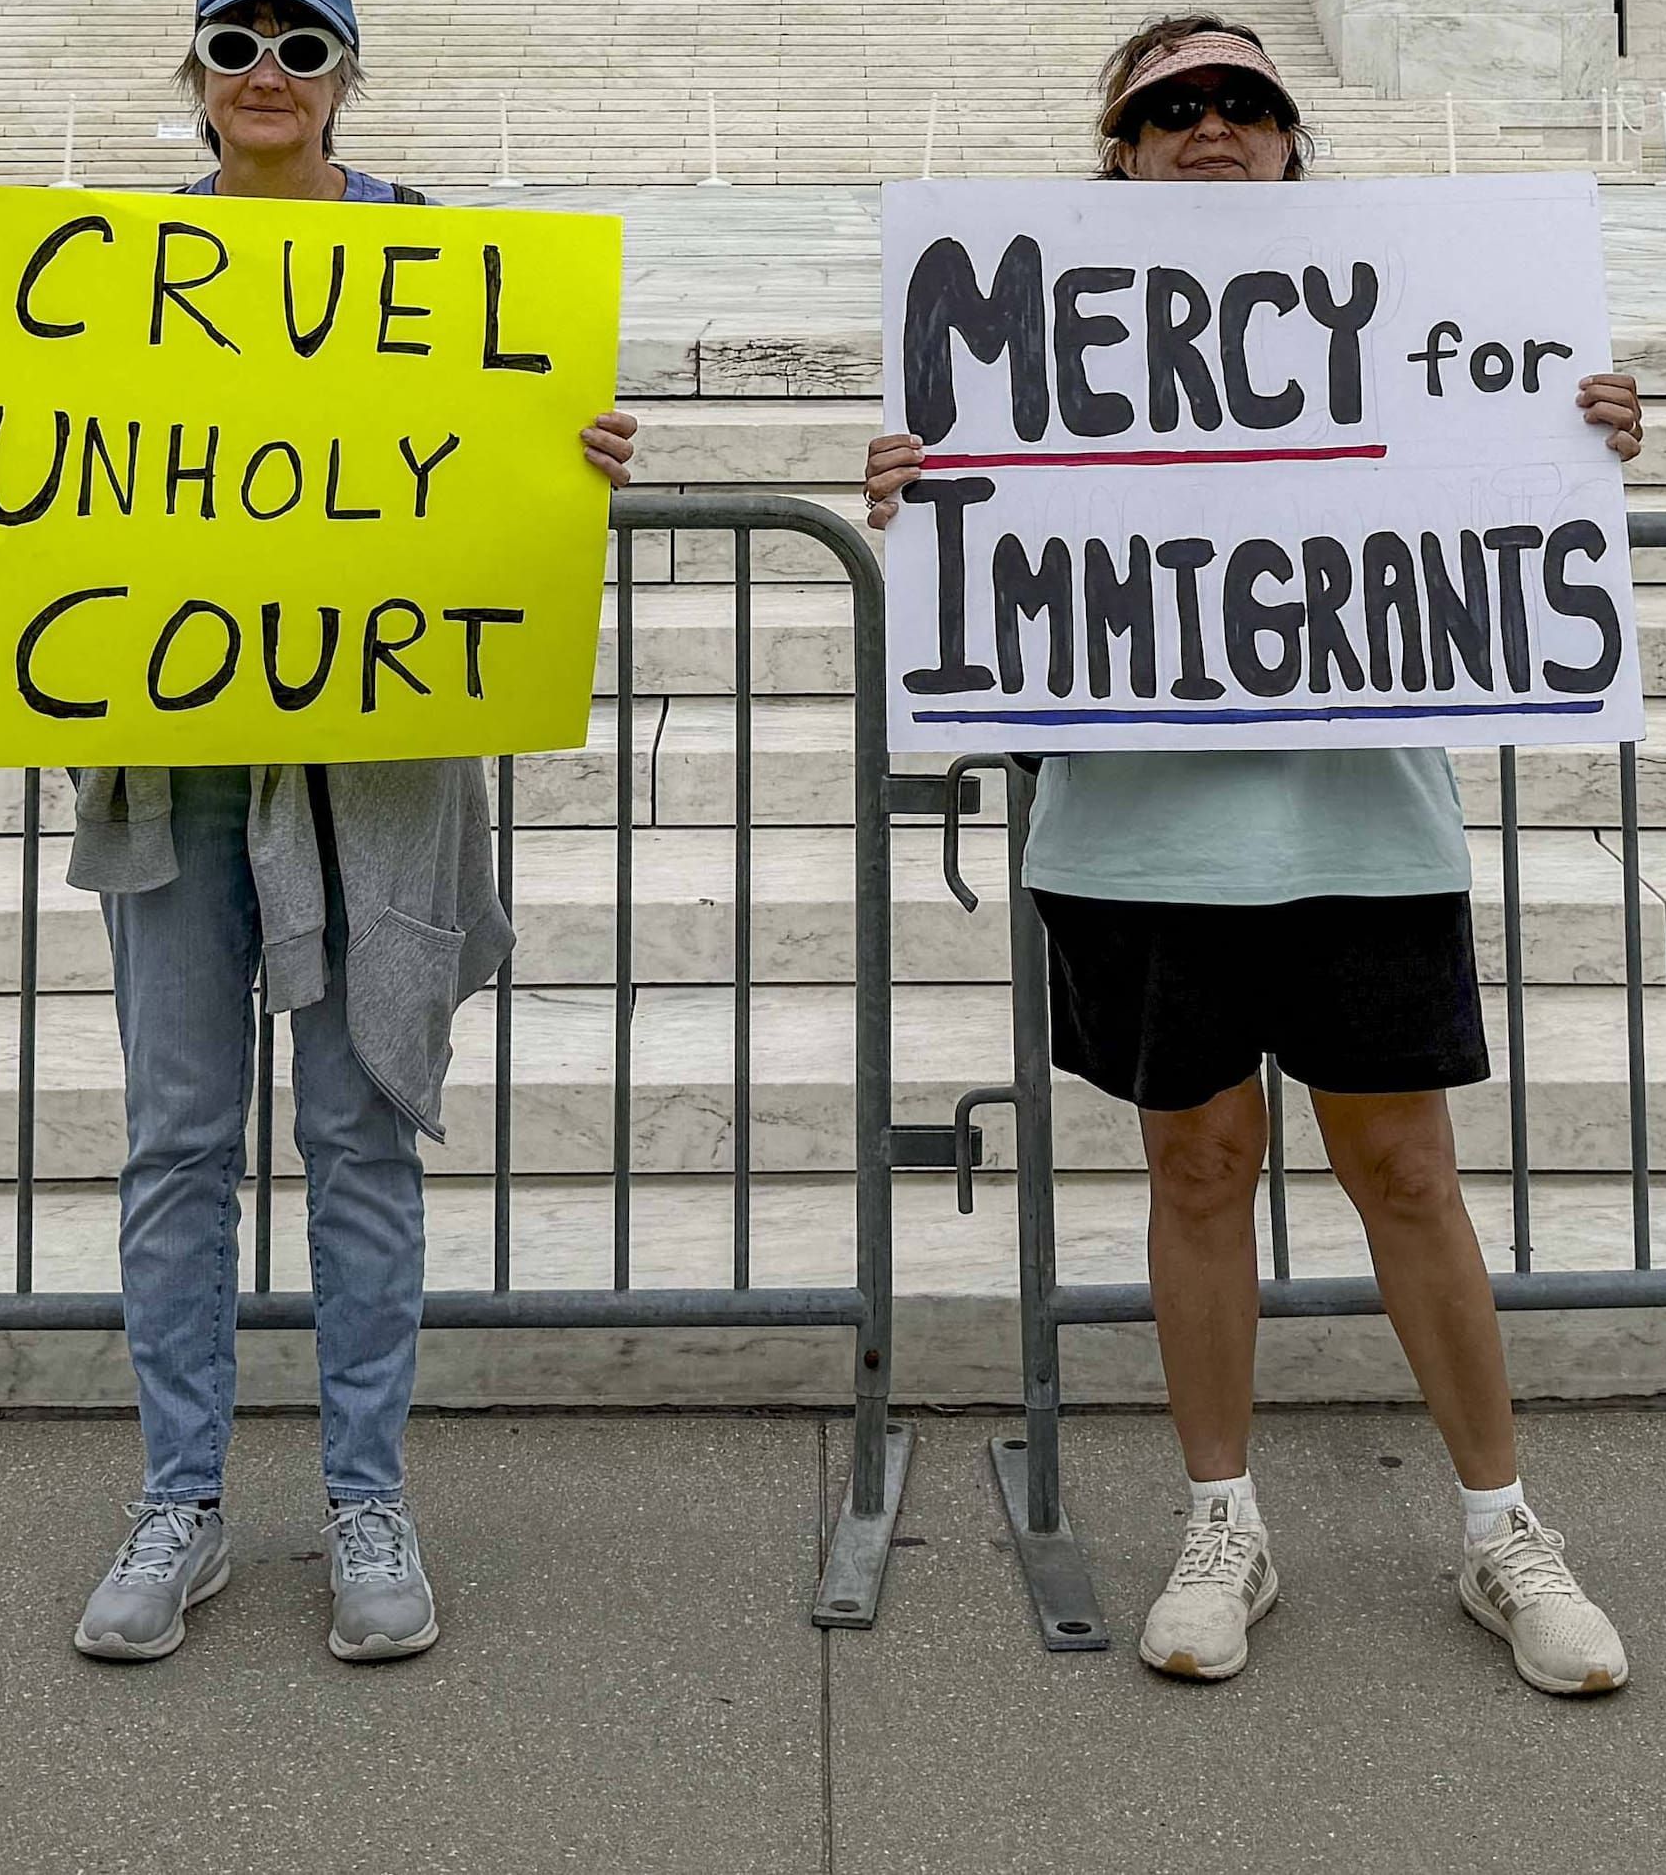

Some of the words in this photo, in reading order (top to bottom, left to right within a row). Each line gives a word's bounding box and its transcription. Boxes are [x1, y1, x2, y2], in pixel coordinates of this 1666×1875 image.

[15, 215, 552, 375] CRUEL
[903, 233, 1379, 446] MERCY
[1407, 319, 1573, 398] for
[16, 585, 524, 718] COURT
[902, 476, 1622, 702] IMMIGRANTS
